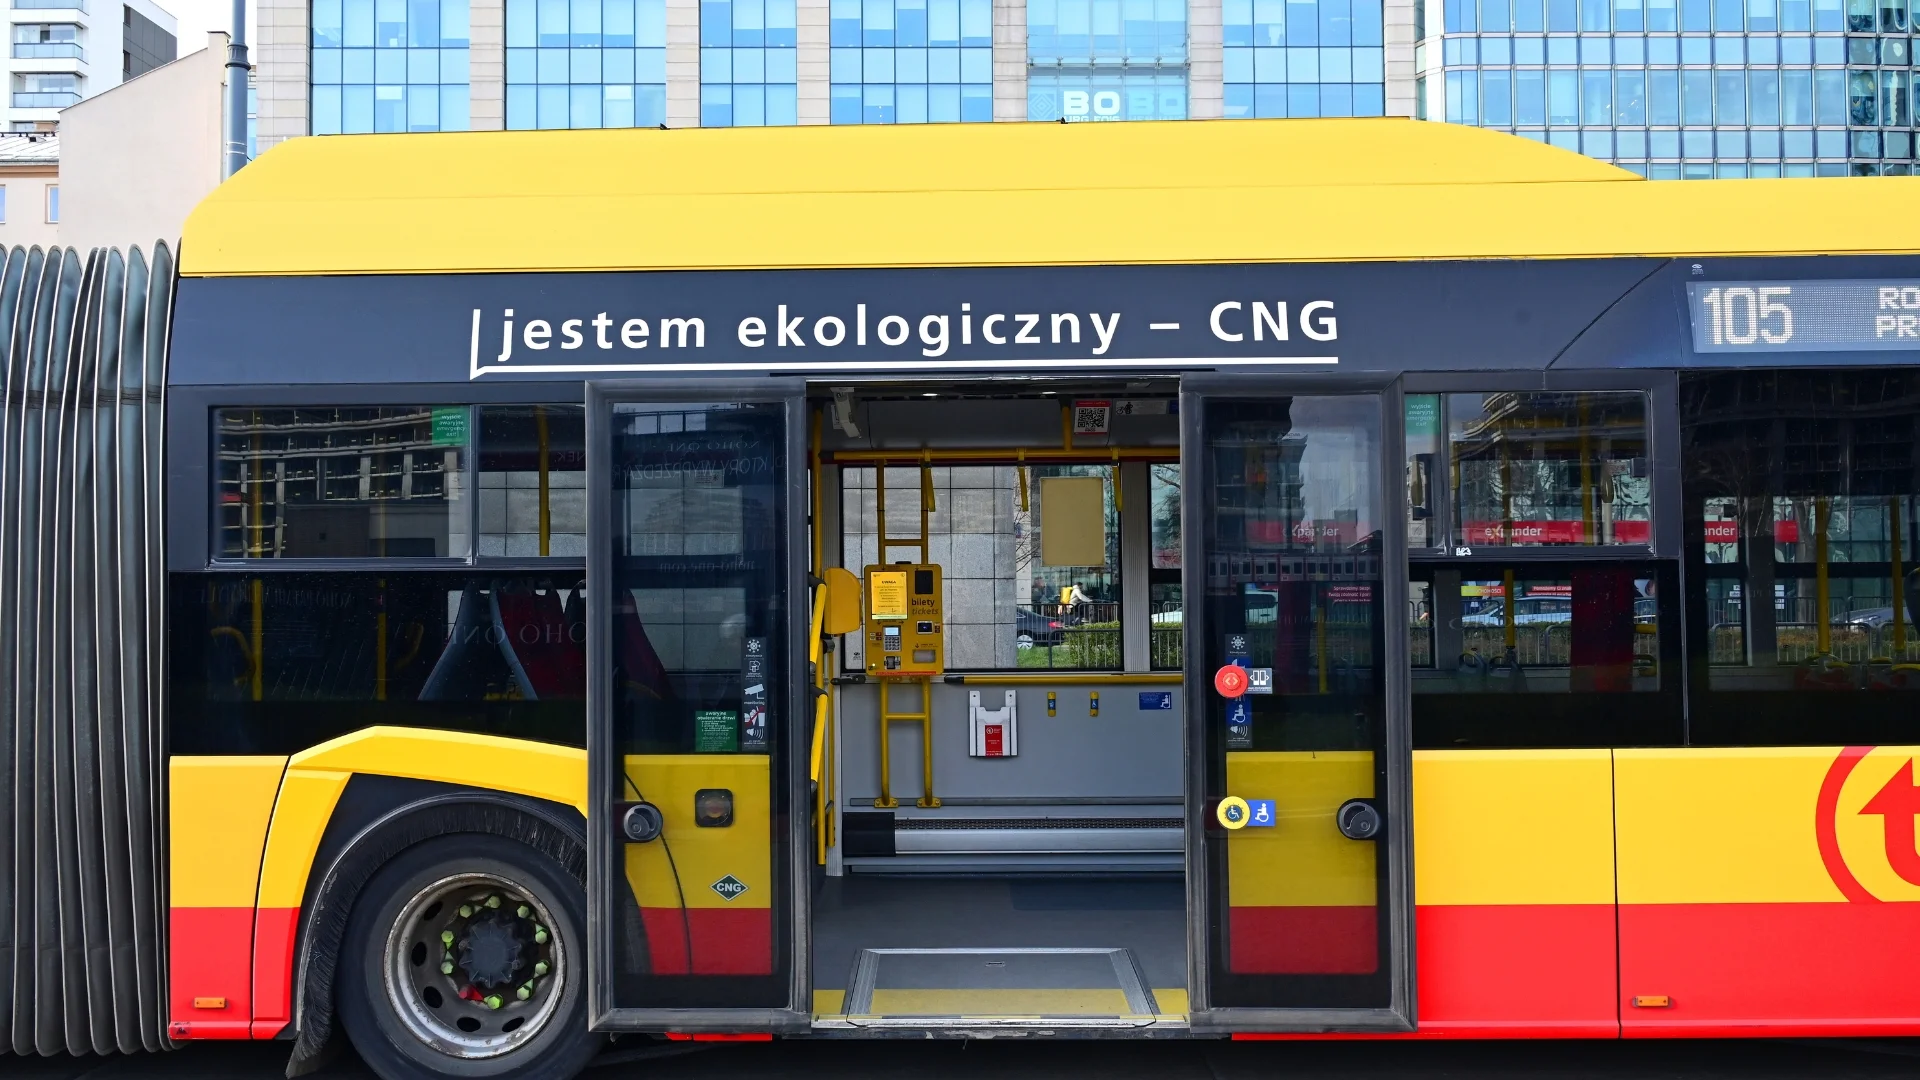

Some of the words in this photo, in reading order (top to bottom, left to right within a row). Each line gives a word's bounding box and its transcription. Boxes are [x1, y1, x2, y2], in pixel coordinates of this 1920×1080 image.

[1878, 287, 1920, 310] RO
[1702, 286, 1793, 345] 105
[497, 308, 706, 362] jestem
[737, 302, 1121, 357] ekologiczny
[1209, 300, 1339, 342] CNG
[1875, 315, 1920, 338] PR
[1485, 524, 1543, 539] expnder
[911, 598, 935, 608] bilety
[911, 607, 939, 615] tickets
[716, 882, 742, 892] CNG
